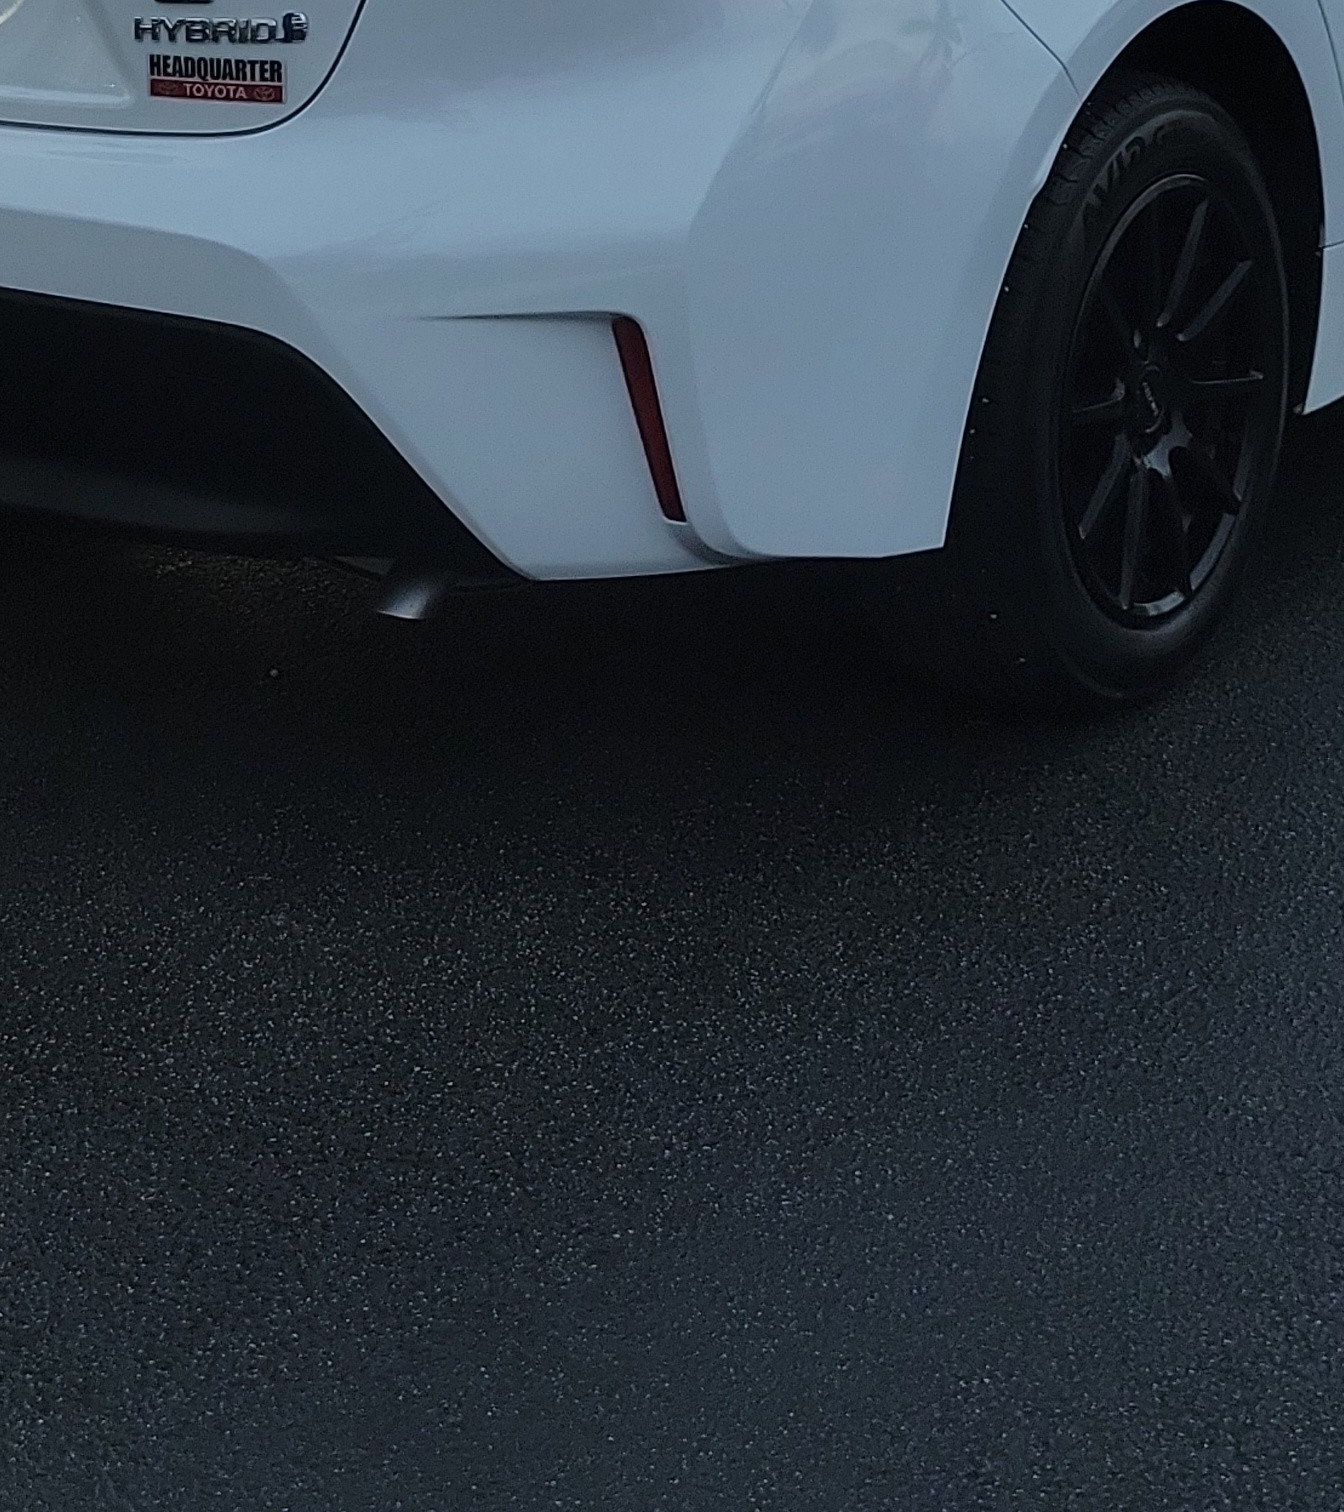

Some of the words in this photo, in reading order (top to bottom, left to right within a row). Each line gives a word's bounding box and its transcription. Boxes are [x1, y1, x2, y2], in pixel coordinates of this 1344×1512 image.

[133, 16, 277, 43] HYBRID
[149, 54, 283, 83] HEADQUARTER
[183, 83, 248, 99] TOYOTA
